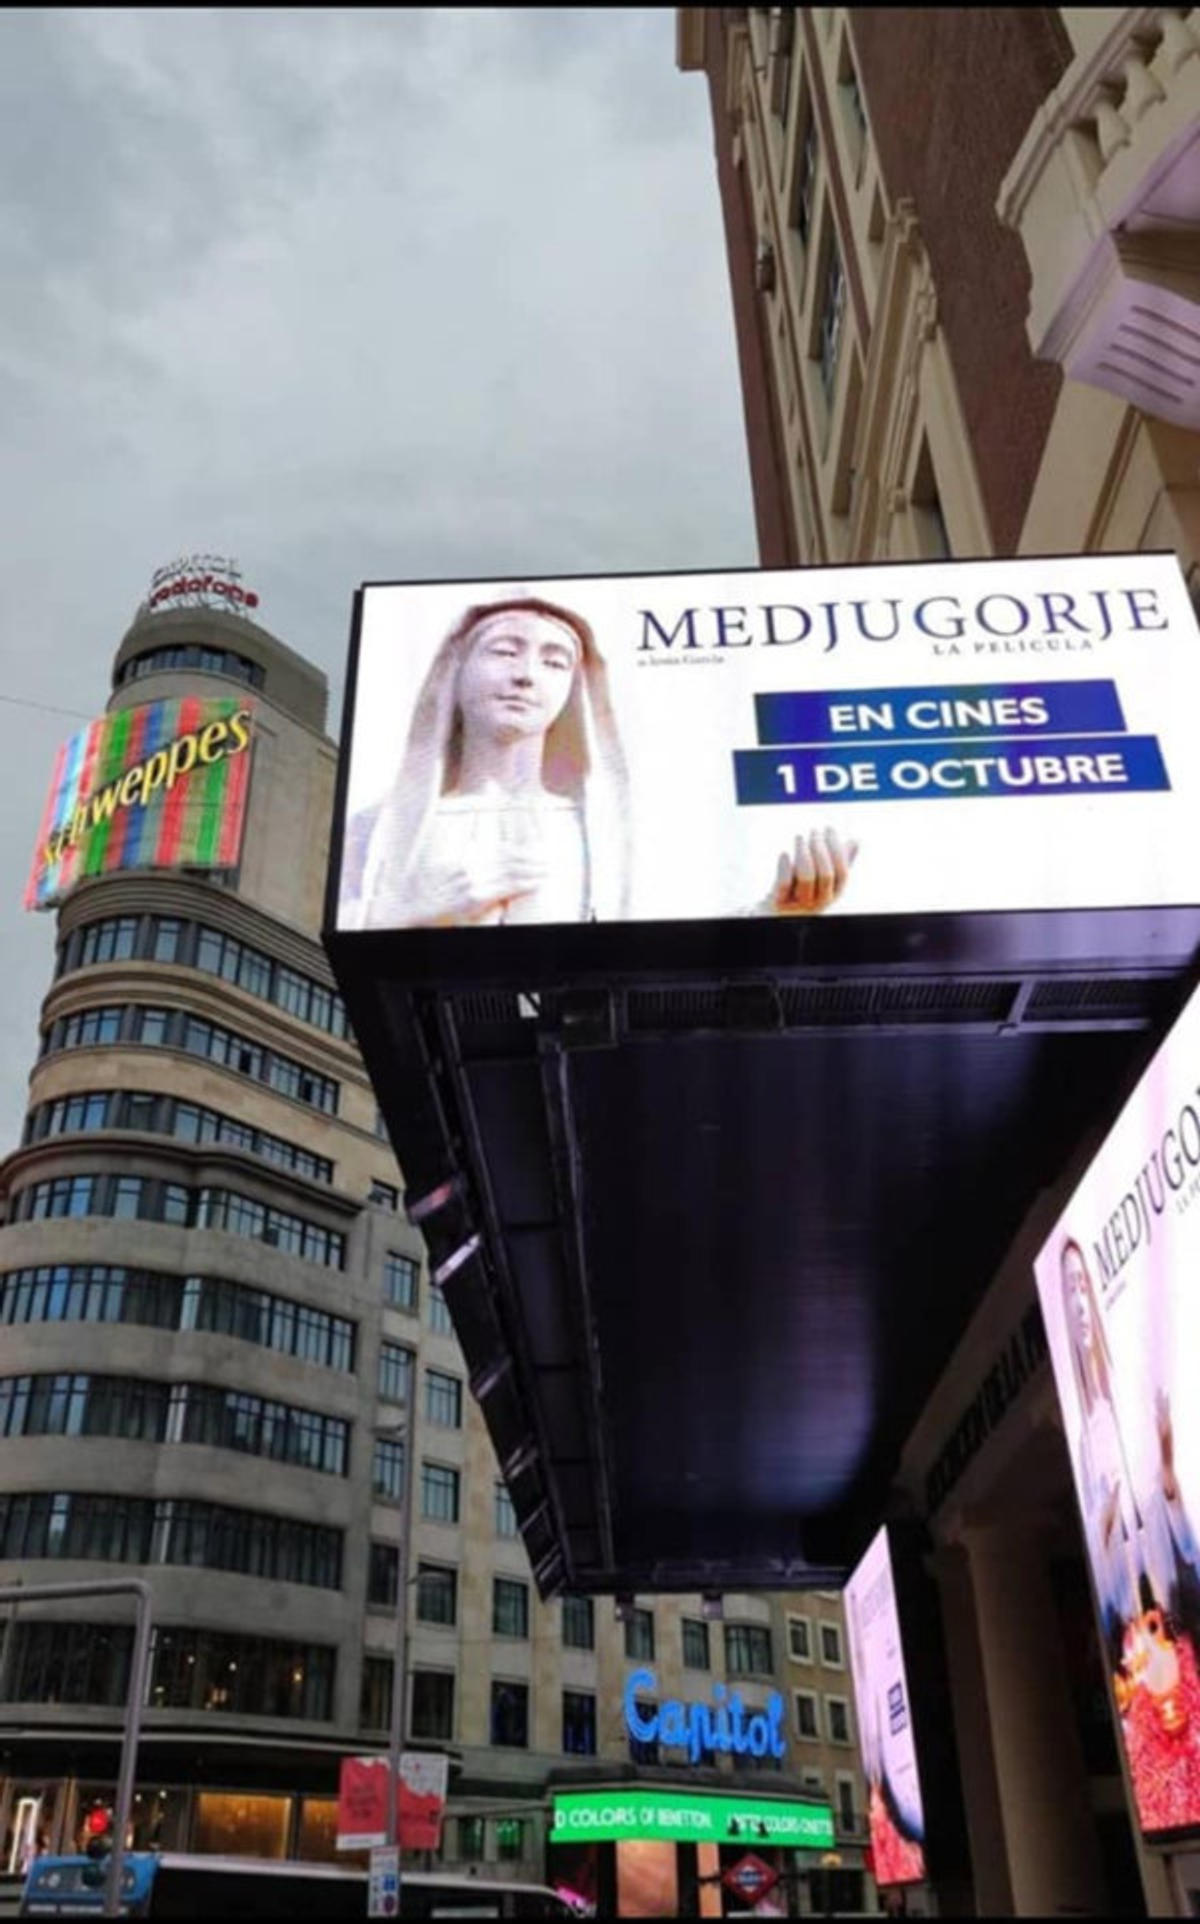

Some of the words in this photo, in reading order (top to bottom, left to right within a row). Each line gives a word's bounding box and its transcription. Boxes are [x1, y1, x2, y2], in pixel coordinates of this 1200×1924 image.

[636, 587, 1171, 653] MEDJUGORJE
[932, 643, 961, 656] LA
[829, 704, 894, 733] EN
[906, 697, 1050, 729] CINES
[777, 764, 796, 795] 1
[815, 763, 880, 793] DE
[890, 753, 1127, 788] OCTUBRE
[1092, 1084, 1200, 1293] MEDJUGO
[624, 1667, 785, 1764] Capitol
[569, 1807, 637, 1828] COLORS
